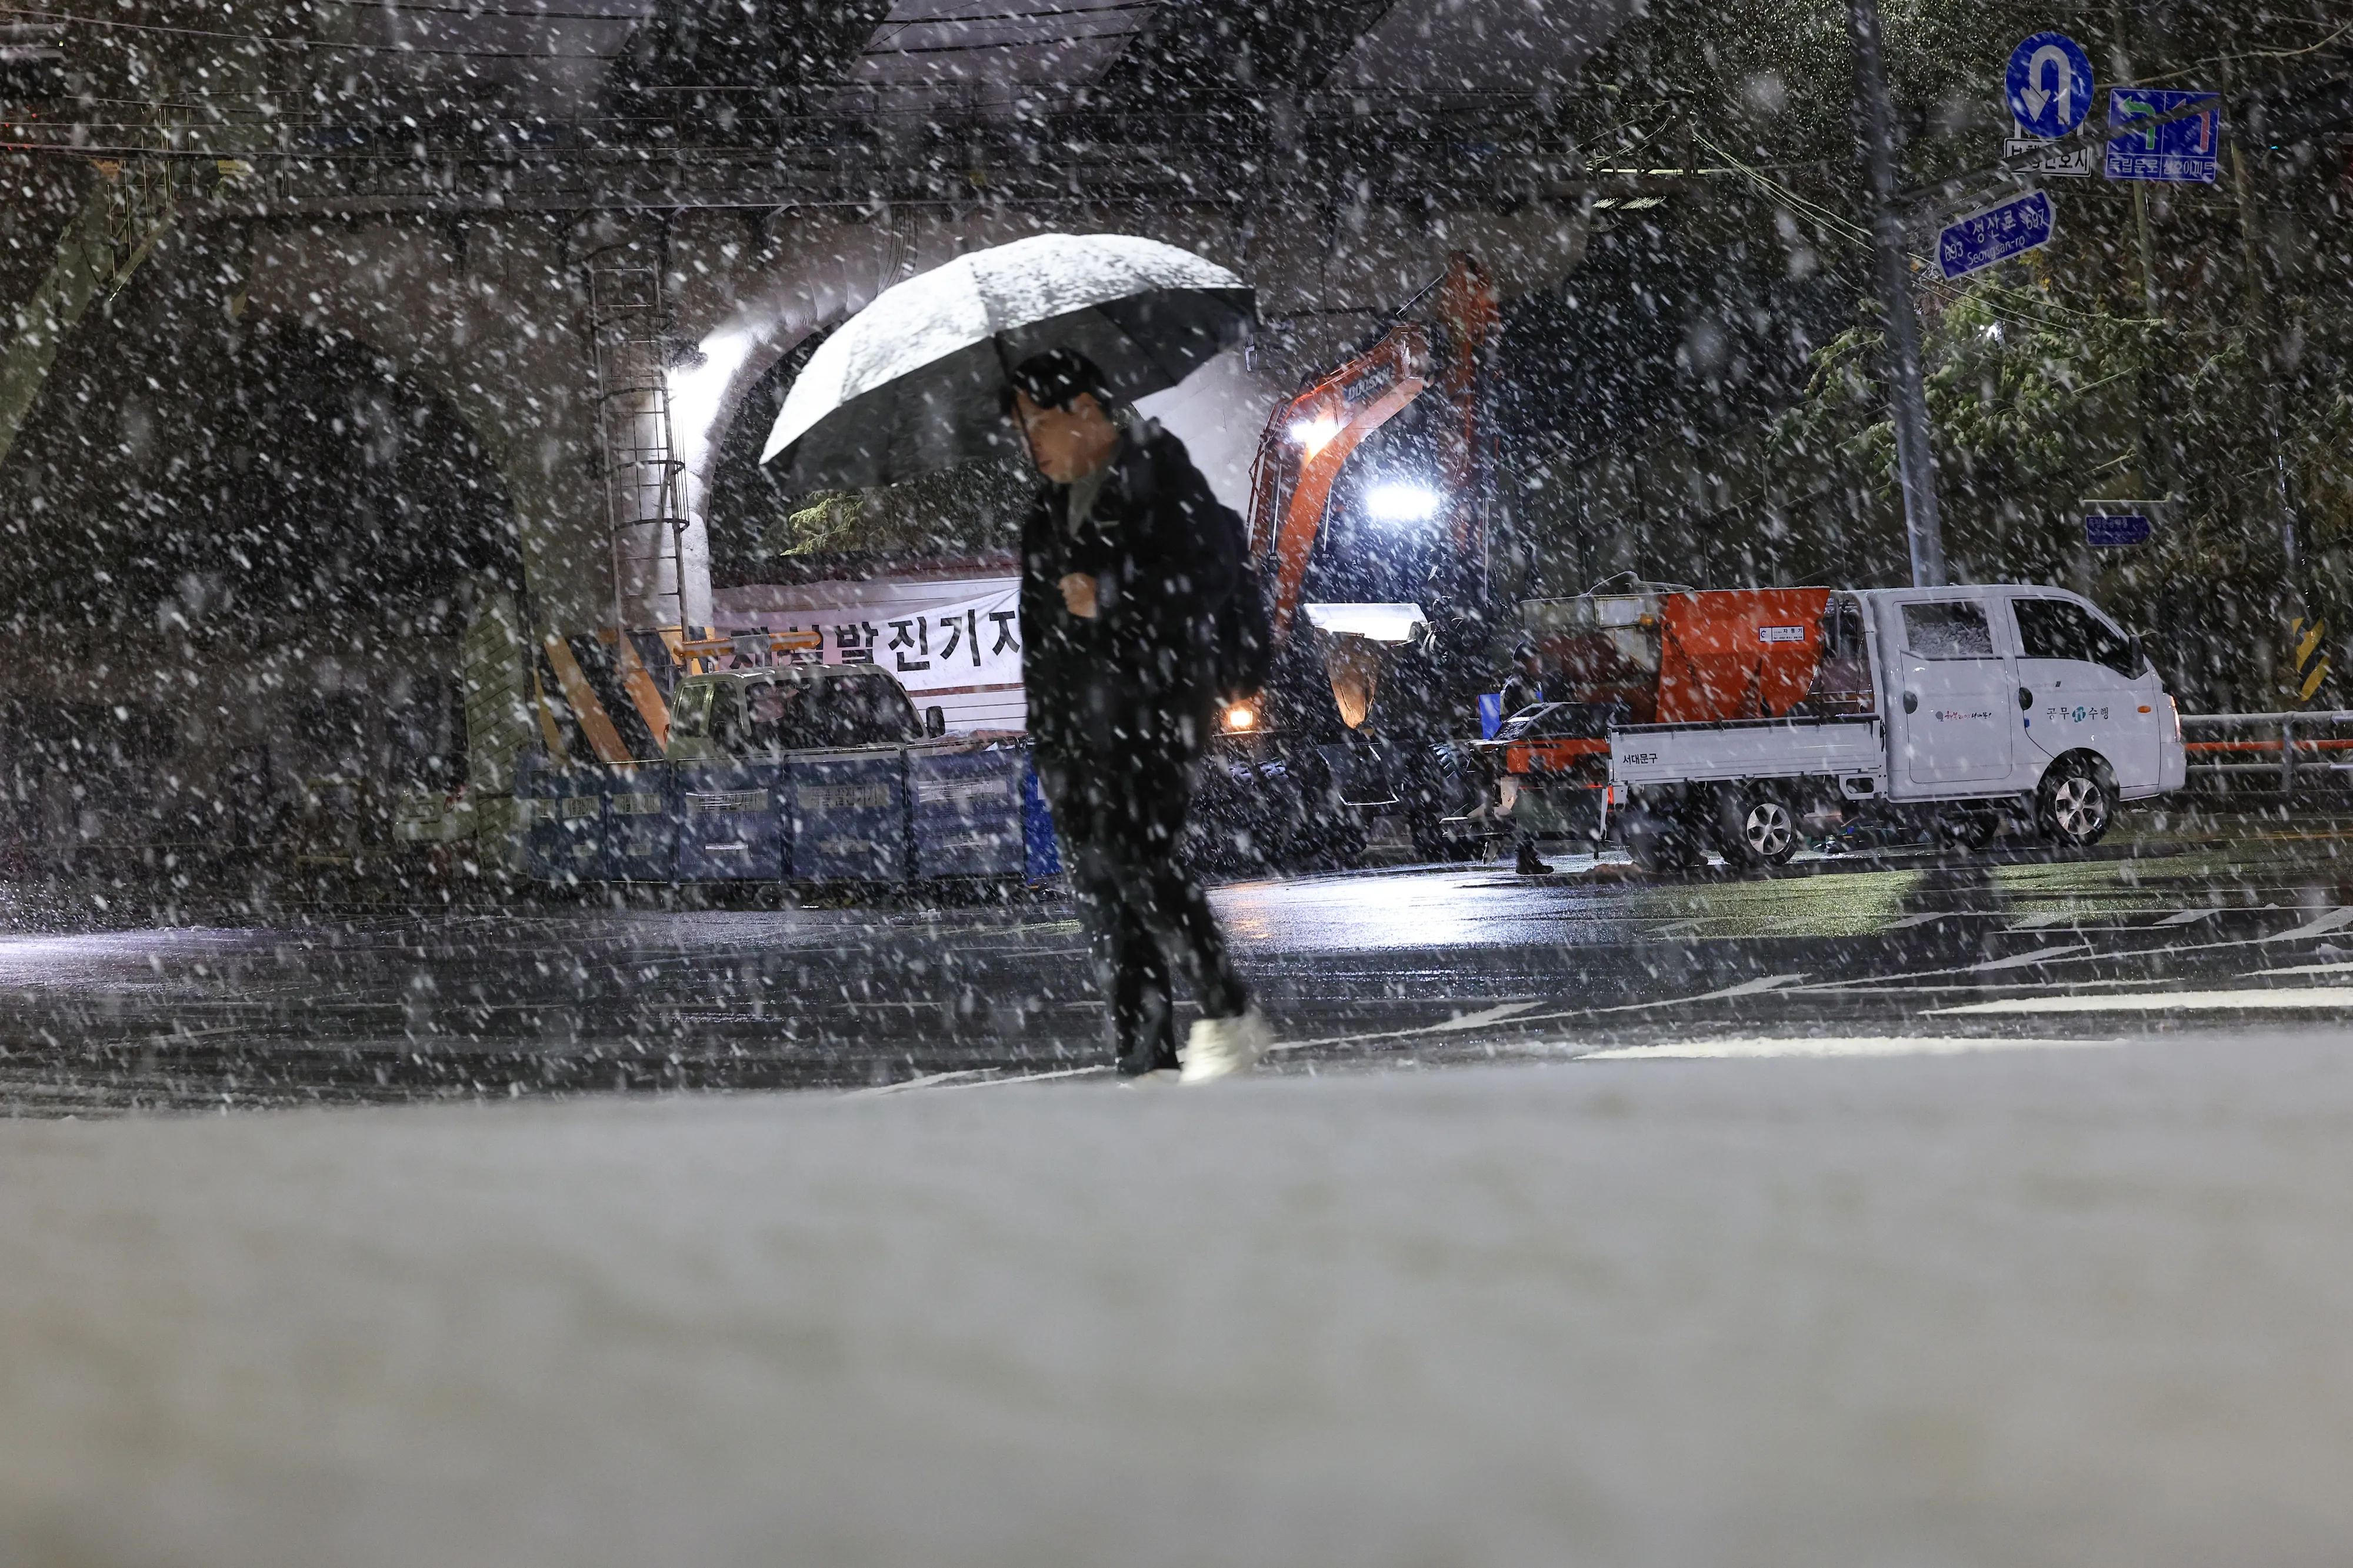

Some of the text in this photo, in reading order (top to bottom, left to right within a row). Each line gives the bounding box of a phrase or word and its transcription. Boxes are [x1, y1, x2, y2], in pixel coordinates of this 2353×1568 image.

[1972, 210, 2017, 243] 성산로
[2026, 208, 2045, 230] 697
[1945, 241, 1963, 262] 693
[1967, 236, 2025, 265] Seongsan-ro
[2047, 707, 2109, 720] 공무 수행
[1623, 753, 1658, 765] 서대문구
